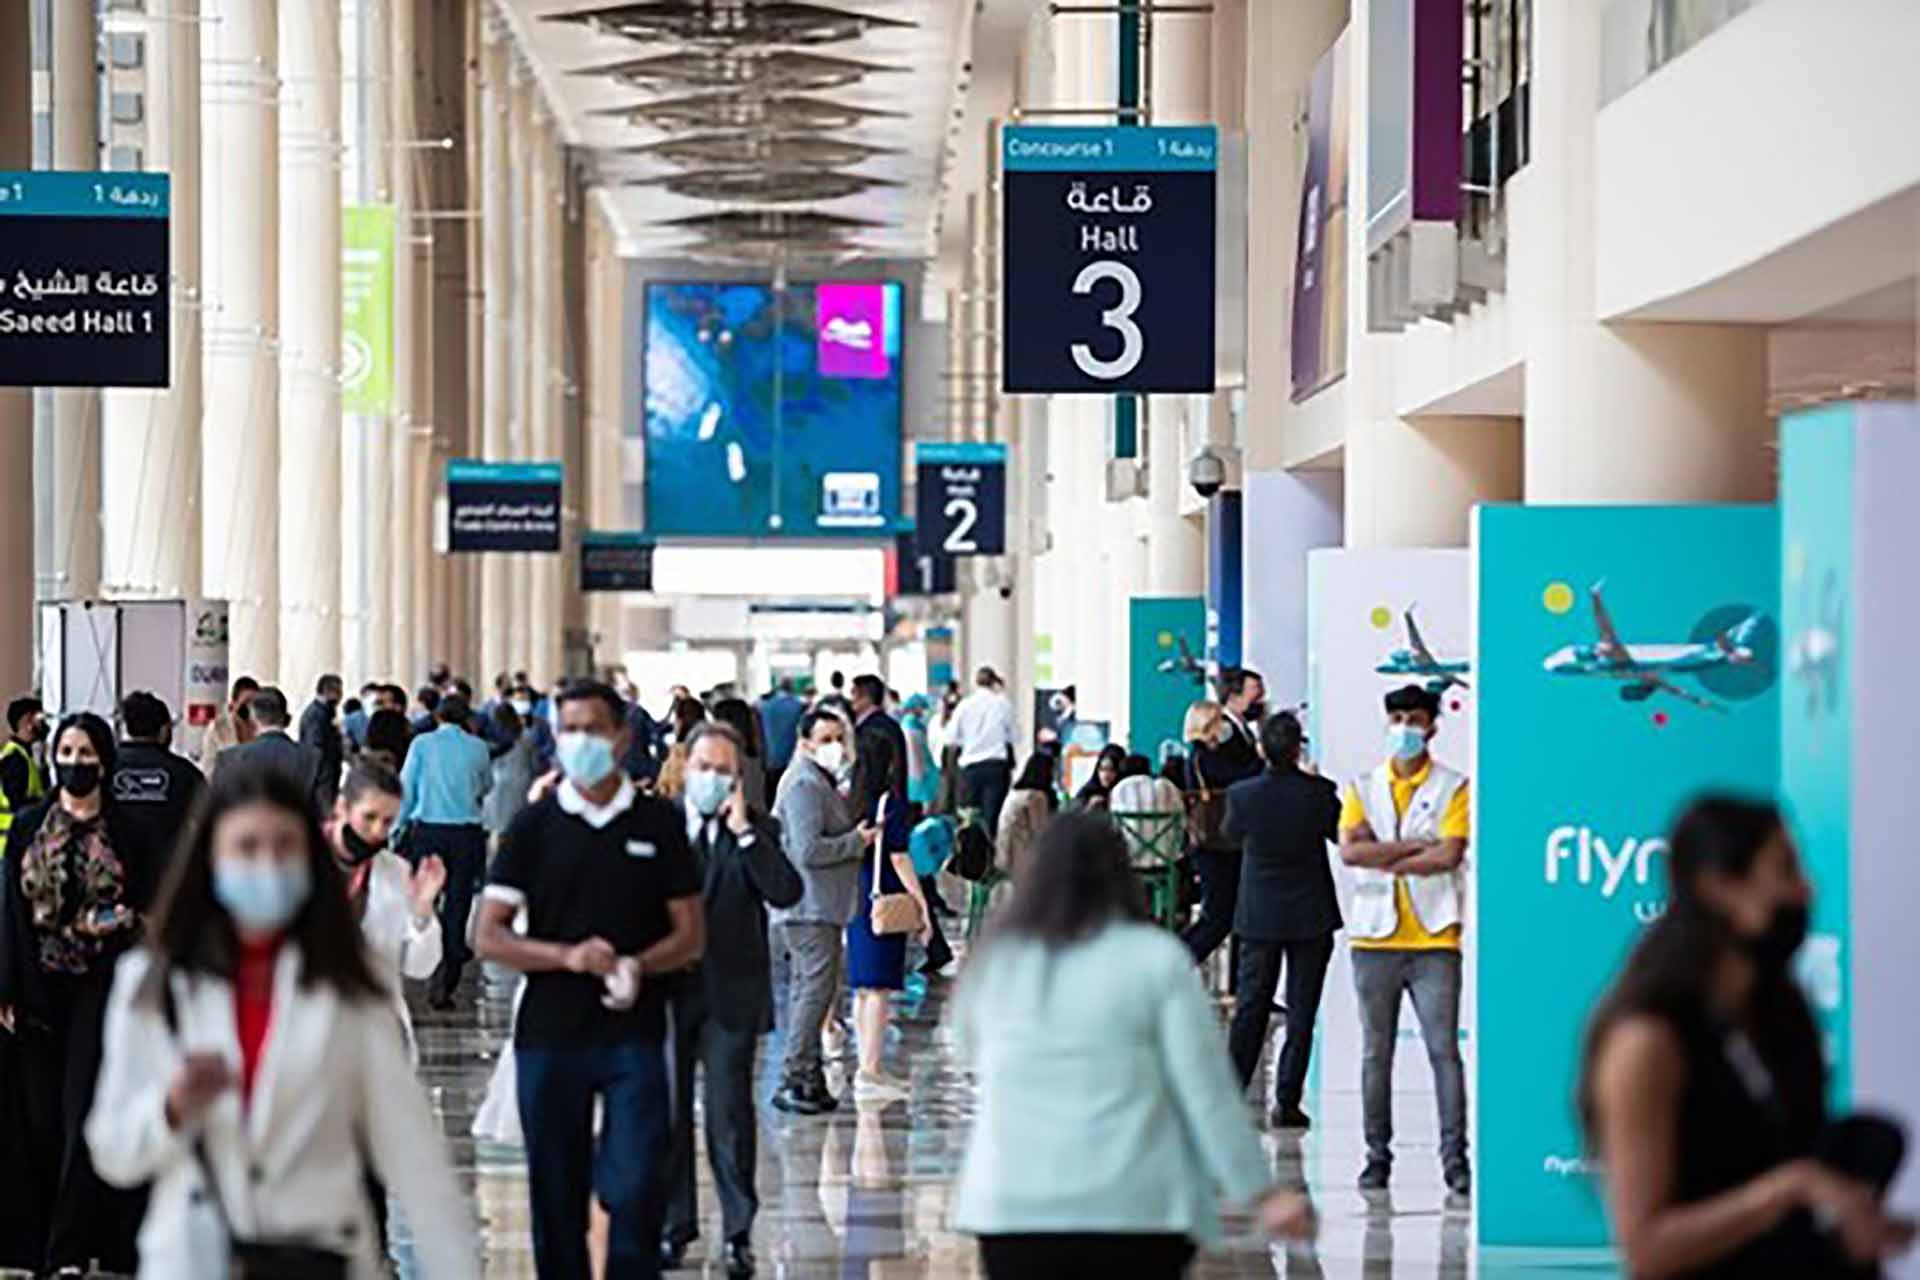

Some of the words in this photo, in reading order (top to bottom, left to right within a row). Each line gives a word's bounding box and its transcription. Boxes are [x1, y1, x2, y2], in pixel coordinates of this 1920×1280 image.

[1008, 138, 1100, 157] Concourse
[1104, 138, 1114, 157] 1
[93, 183, 104, 203] 1
[1066, 181, 1153, 213] قاعة
[1080, 224, 1140, 252] Hall
[13, 268, 90, 301] الشيخ
[95, 271, 159, 296] قاعة
[0, 308, 76, 334] Saeed
[83, 309, 134, 334] Hall
[141, 309, 153, 334] 1
[1070, 259, 1145, 381] 3
[943, 498, 979, 552] 2
[916, 555, 932, 593] 1
[1545, 825, 1670, 899] flyn
